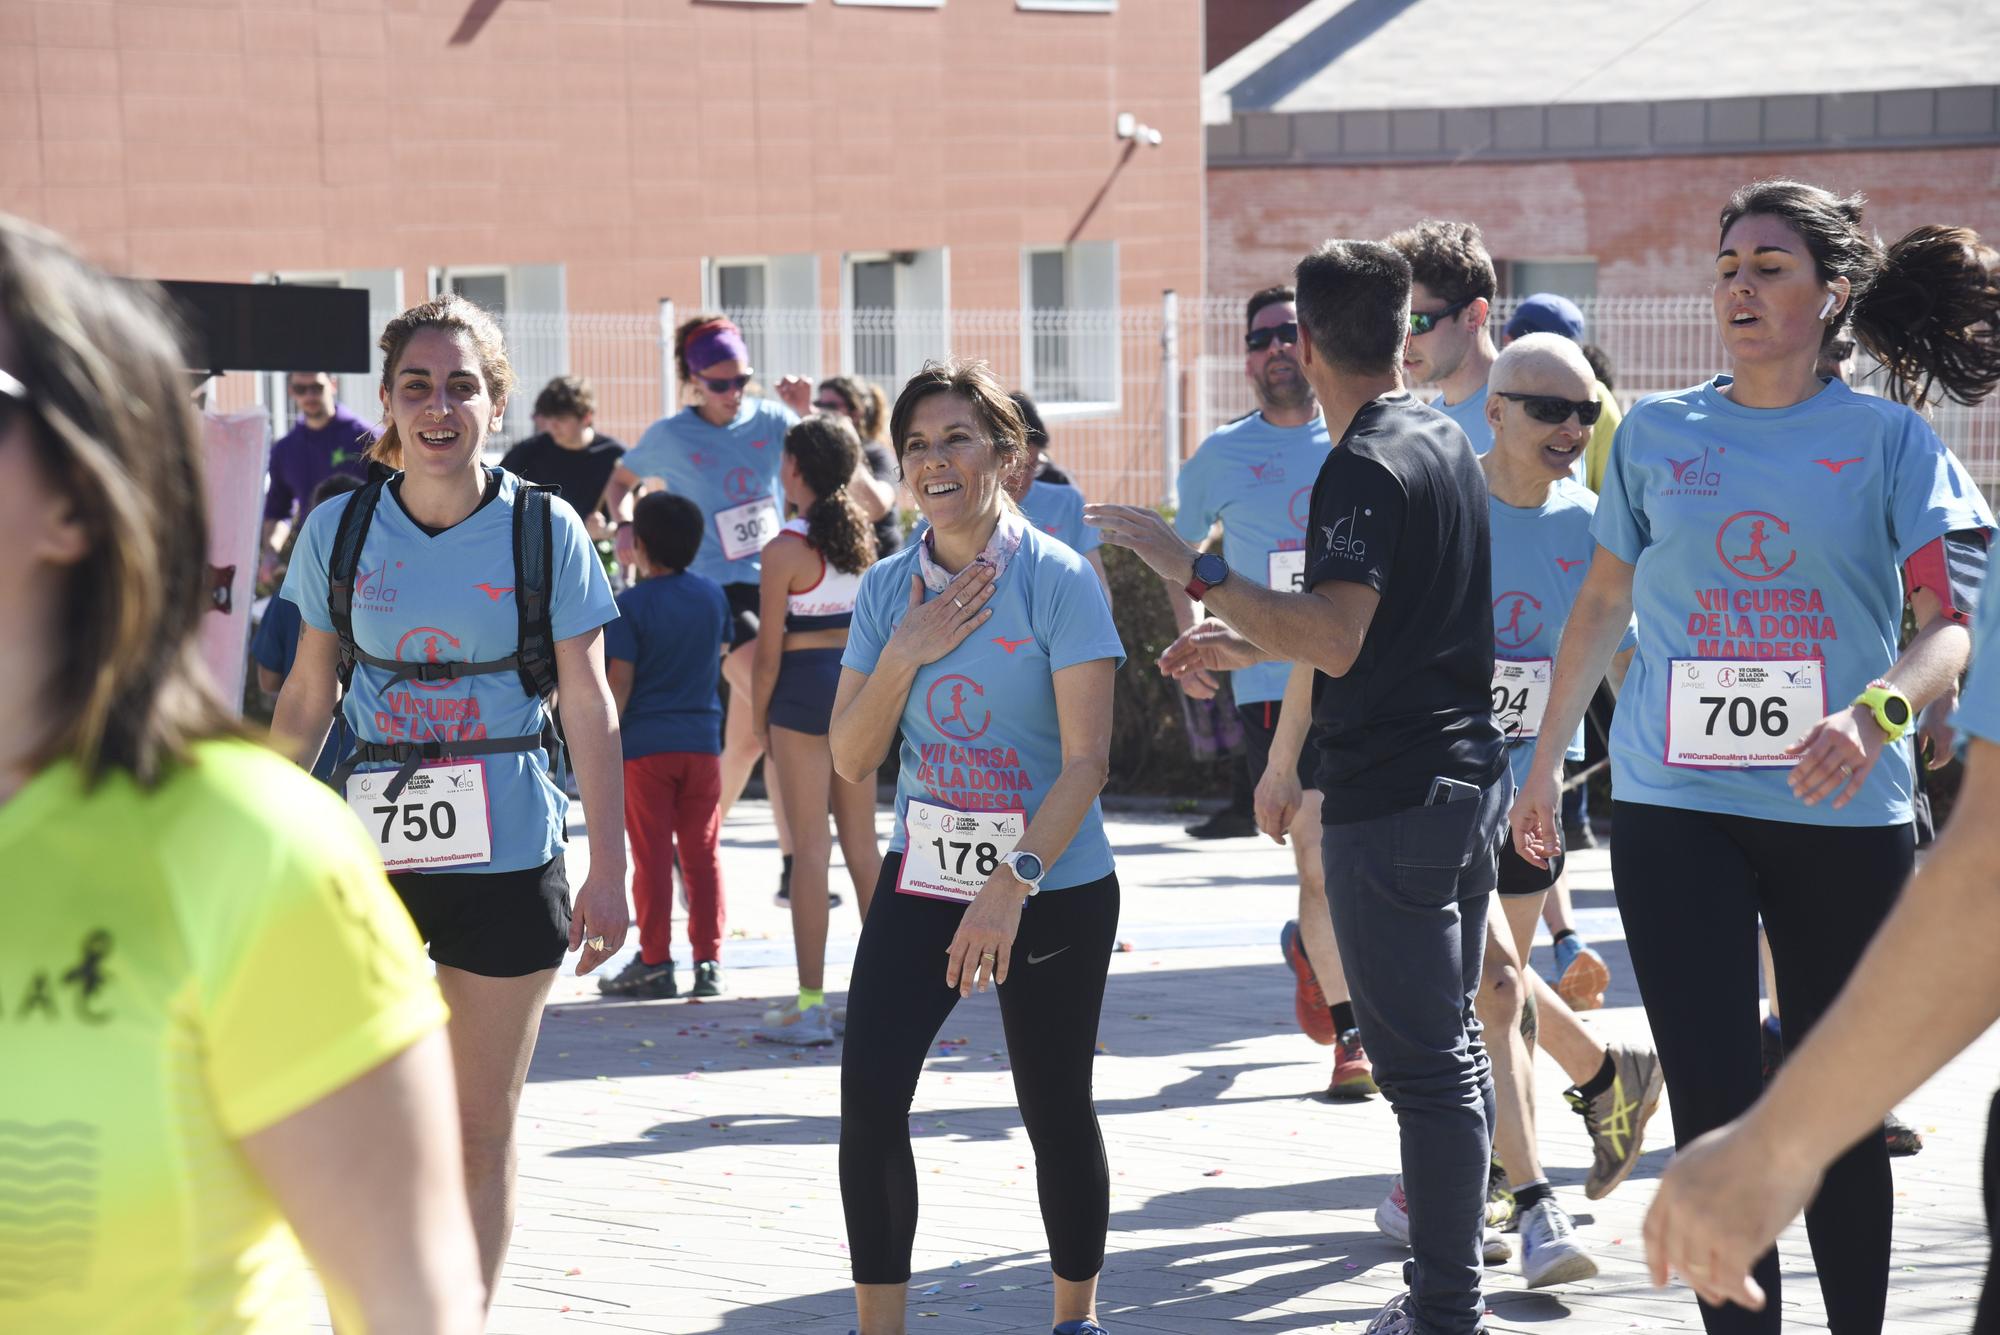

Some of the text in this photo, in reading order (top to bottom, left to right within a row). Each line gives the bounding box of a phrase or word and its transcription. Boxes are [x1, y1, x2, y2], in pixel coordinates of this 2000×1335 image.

[1664, 446, 1725, 486] Vela
[1320, 505, 1371, 556] Vela
[1696, 588, 1825, 614] VII CURSA
[1687, 613, 1838, 640] DE LA DONA
[375, 712, 406, 736] DE
[1700, 696, 1789, 737] 706
[920, 743, 1020, 768] VII CURSA
[917, 762, 1033, 791] DE LA DONA
[373, 800, 456, 843] 750
[932, 837, 999, 876] 178
